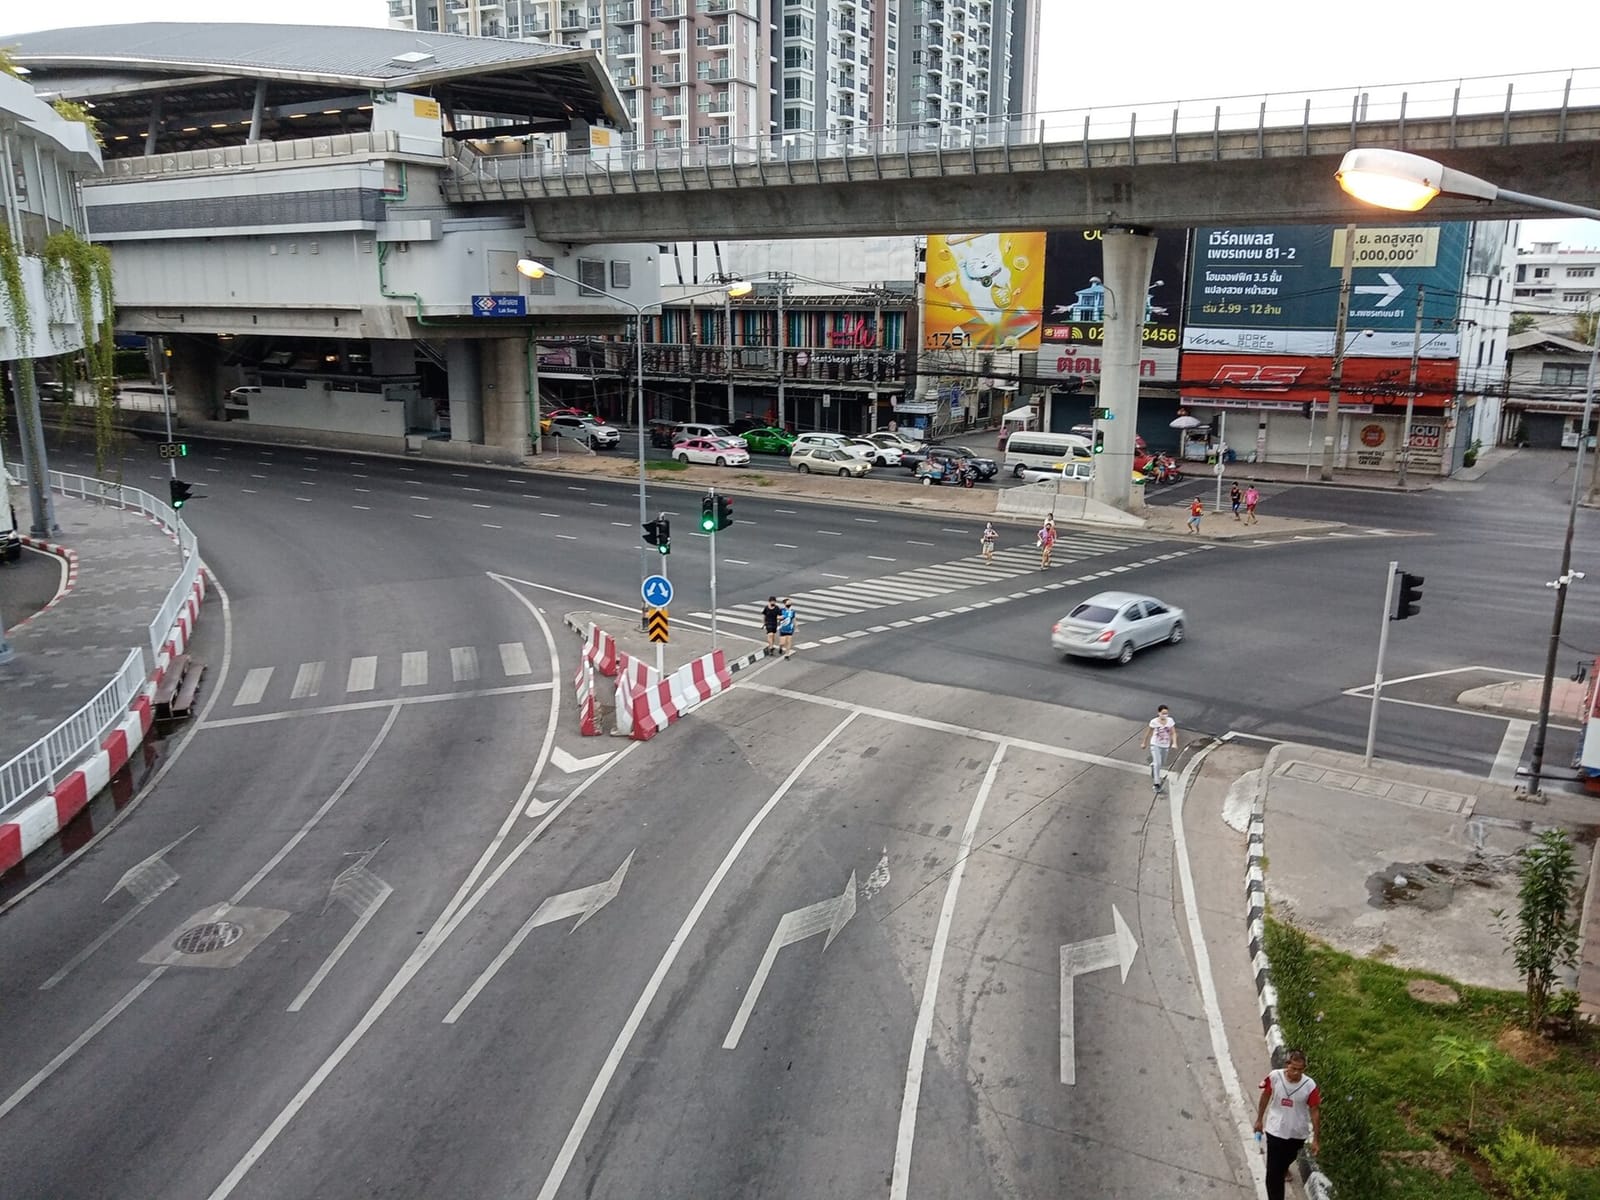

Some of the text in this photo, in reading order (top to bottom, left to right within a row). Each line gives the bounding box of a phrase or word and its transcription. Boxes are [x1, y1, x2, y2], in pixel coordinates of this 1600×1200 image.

[1209, 231, 1274, 245] เวิร์คเพลส
[1374, 234, 1423, 247] ลดสูงสุด
[1208, 248, 1262, 259] เพชรเกษม
[1254, 273, 1268, 281] 3.5
[1251, 304, 1262, 314] 12
[1412, 426, 1438, 436] IQUI
